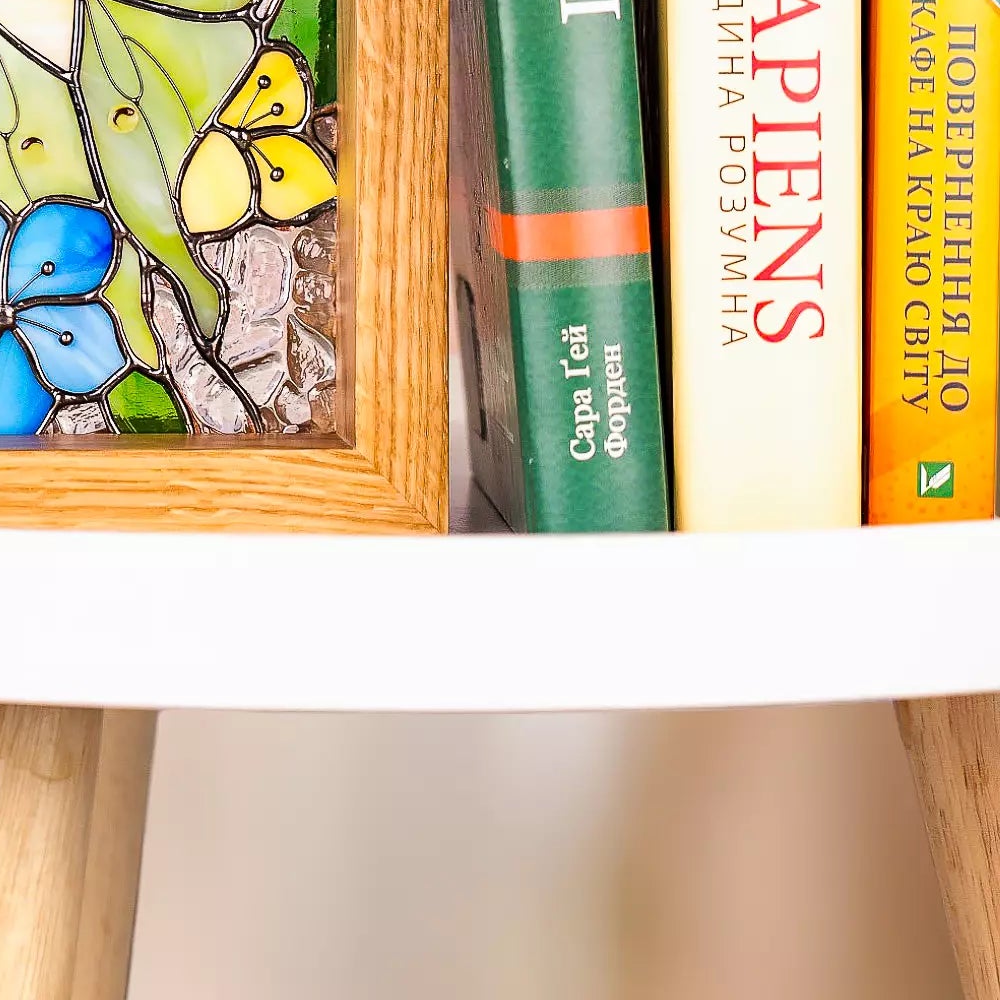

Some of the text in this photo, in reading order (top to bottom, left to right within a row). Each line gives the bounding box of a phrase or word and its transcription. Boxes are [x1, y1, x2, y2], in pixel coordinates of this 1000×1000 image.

[908, 107, 935, 161] НА
[718, 134, 749, 347] РОЗУМНА
[904, 173, 934, 289] КРАЮ
[934, 22, 977, 413] ПОВЕРНЕННЯ ДО
[600, 343, 632, 460] Форден
[901, 300, 931, 415] СВІТУ
[569, 387, 598, 462] Сара
